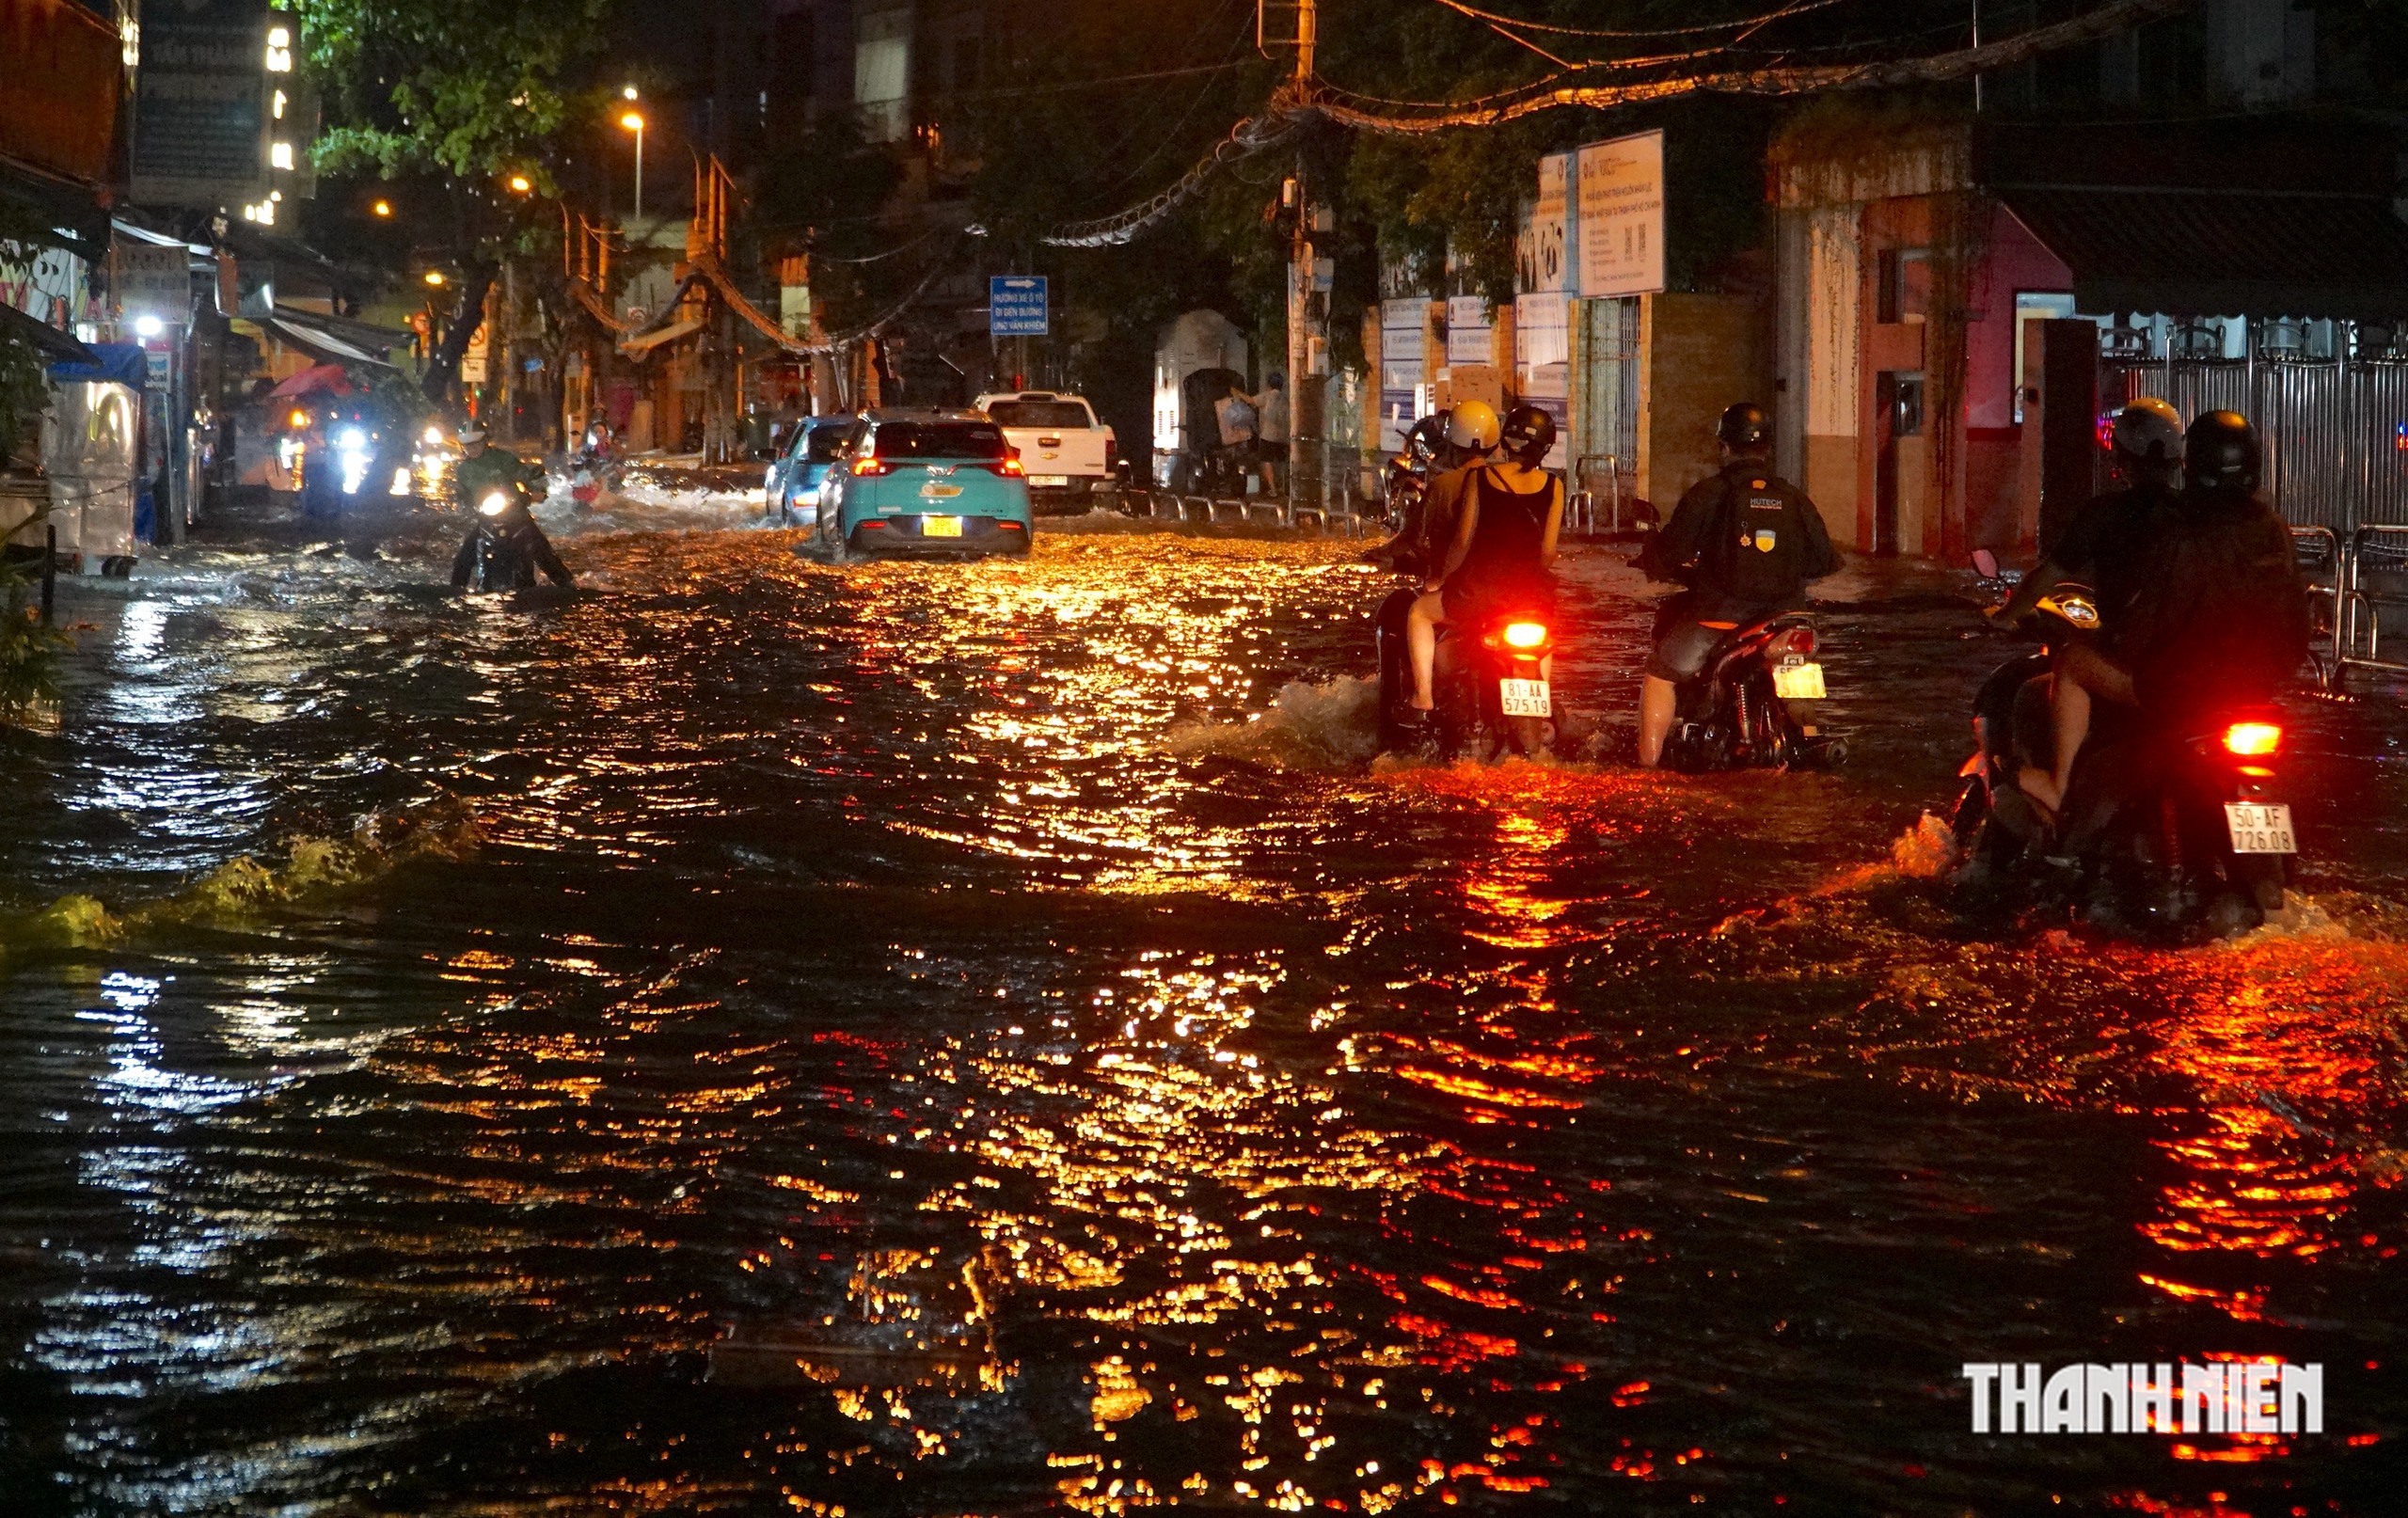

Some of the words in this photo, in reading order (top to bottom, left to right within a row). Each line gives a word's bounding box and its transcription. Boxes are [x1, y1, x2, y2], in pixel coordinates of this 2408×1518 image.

[1750, 498, 1782, 506] HUTECH
[1508, 683, 1543, 698] 81-AA
[1505, 698, 1548, 714] 575.19
[2234, 808, 2280, 828] 50-AF
[2234, 830, 2291, 850] 726.08
